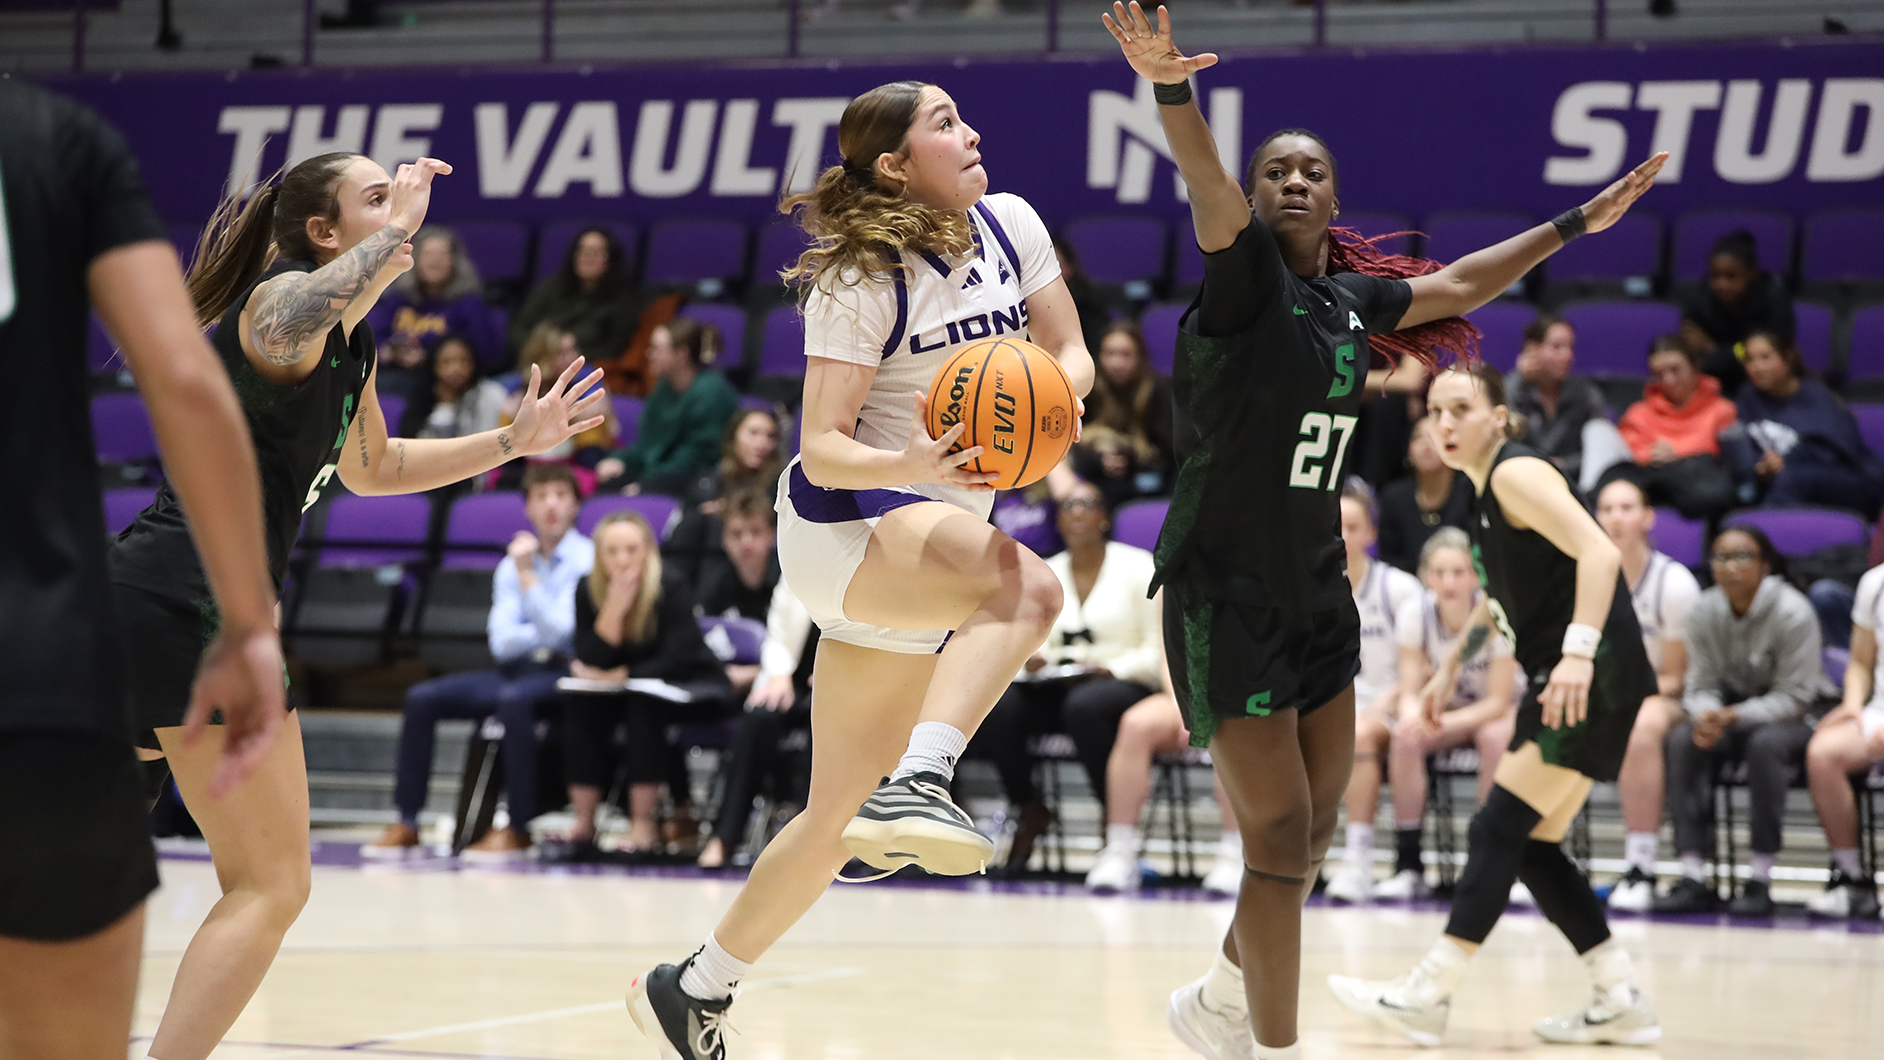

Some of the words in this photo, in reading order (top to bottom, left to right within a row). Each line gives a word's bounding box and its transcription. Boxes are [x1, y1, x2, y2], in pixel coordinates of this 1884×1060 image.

[217, 104, 443, 199] THE
[474, 98, 853, 198] VAULT
[1543, 77, 1884, 186] STUD
[995, 369, 1004, 390] NXT
[1326, 342, 1355, 400] S
[992, 390, 1016, 455] EVO
[1289, 411, 1359, 492] 27
